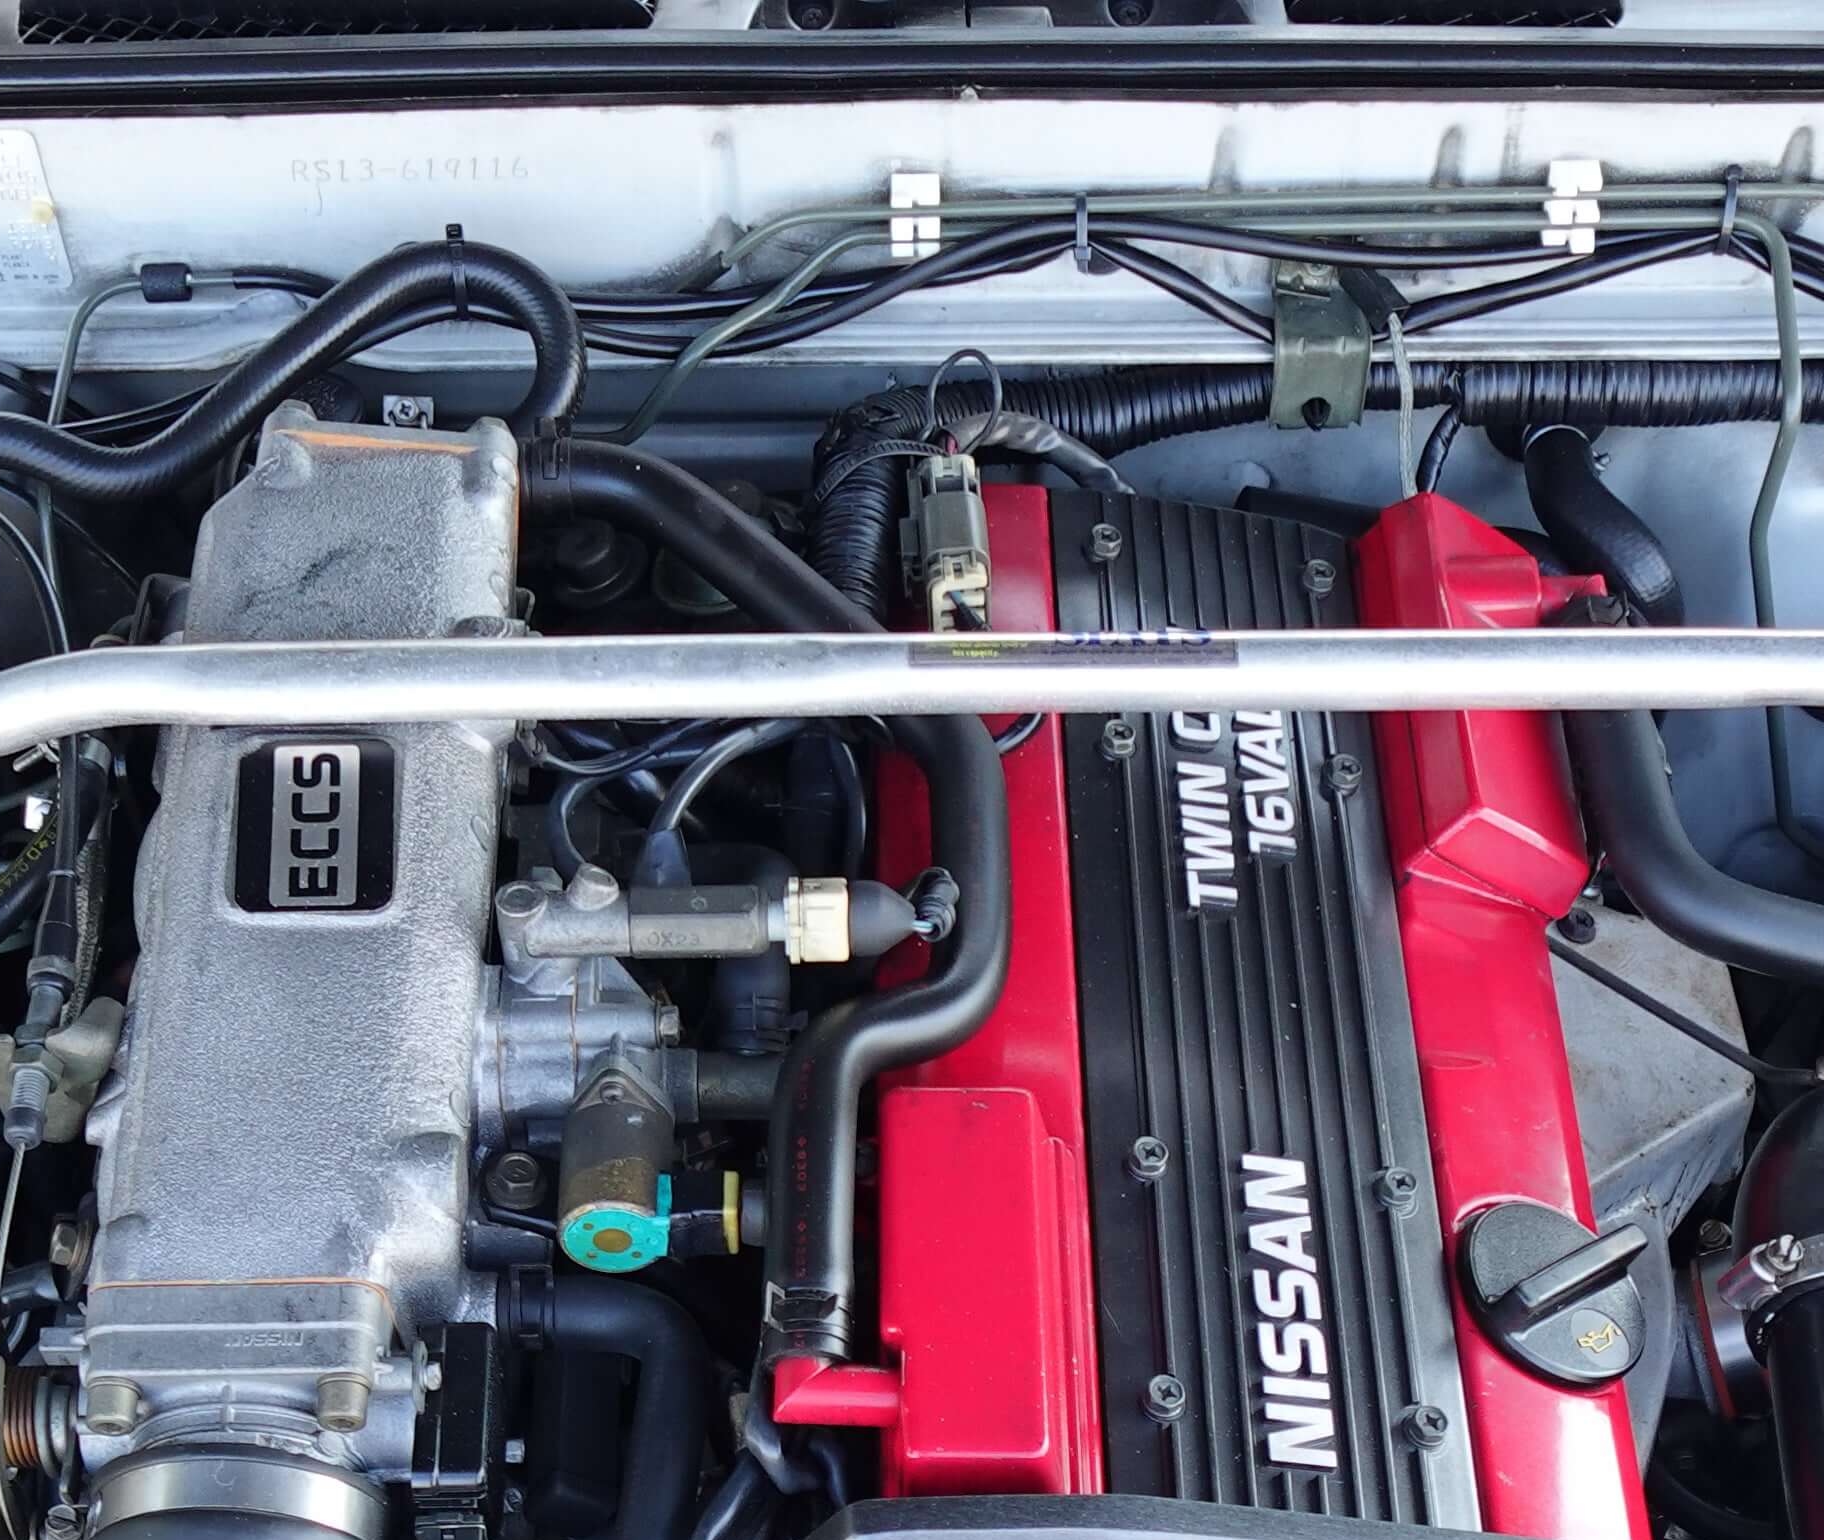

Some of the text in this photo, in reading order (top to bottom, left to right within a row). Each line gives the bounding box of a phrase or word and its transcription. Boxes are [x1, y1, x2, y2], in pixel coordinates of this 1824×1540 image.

[288, 752, 341, 899] ECCS
[1176, 760, 1239, 909] TWIN
[1240, 1153, 1339, 1468] NISSAN
